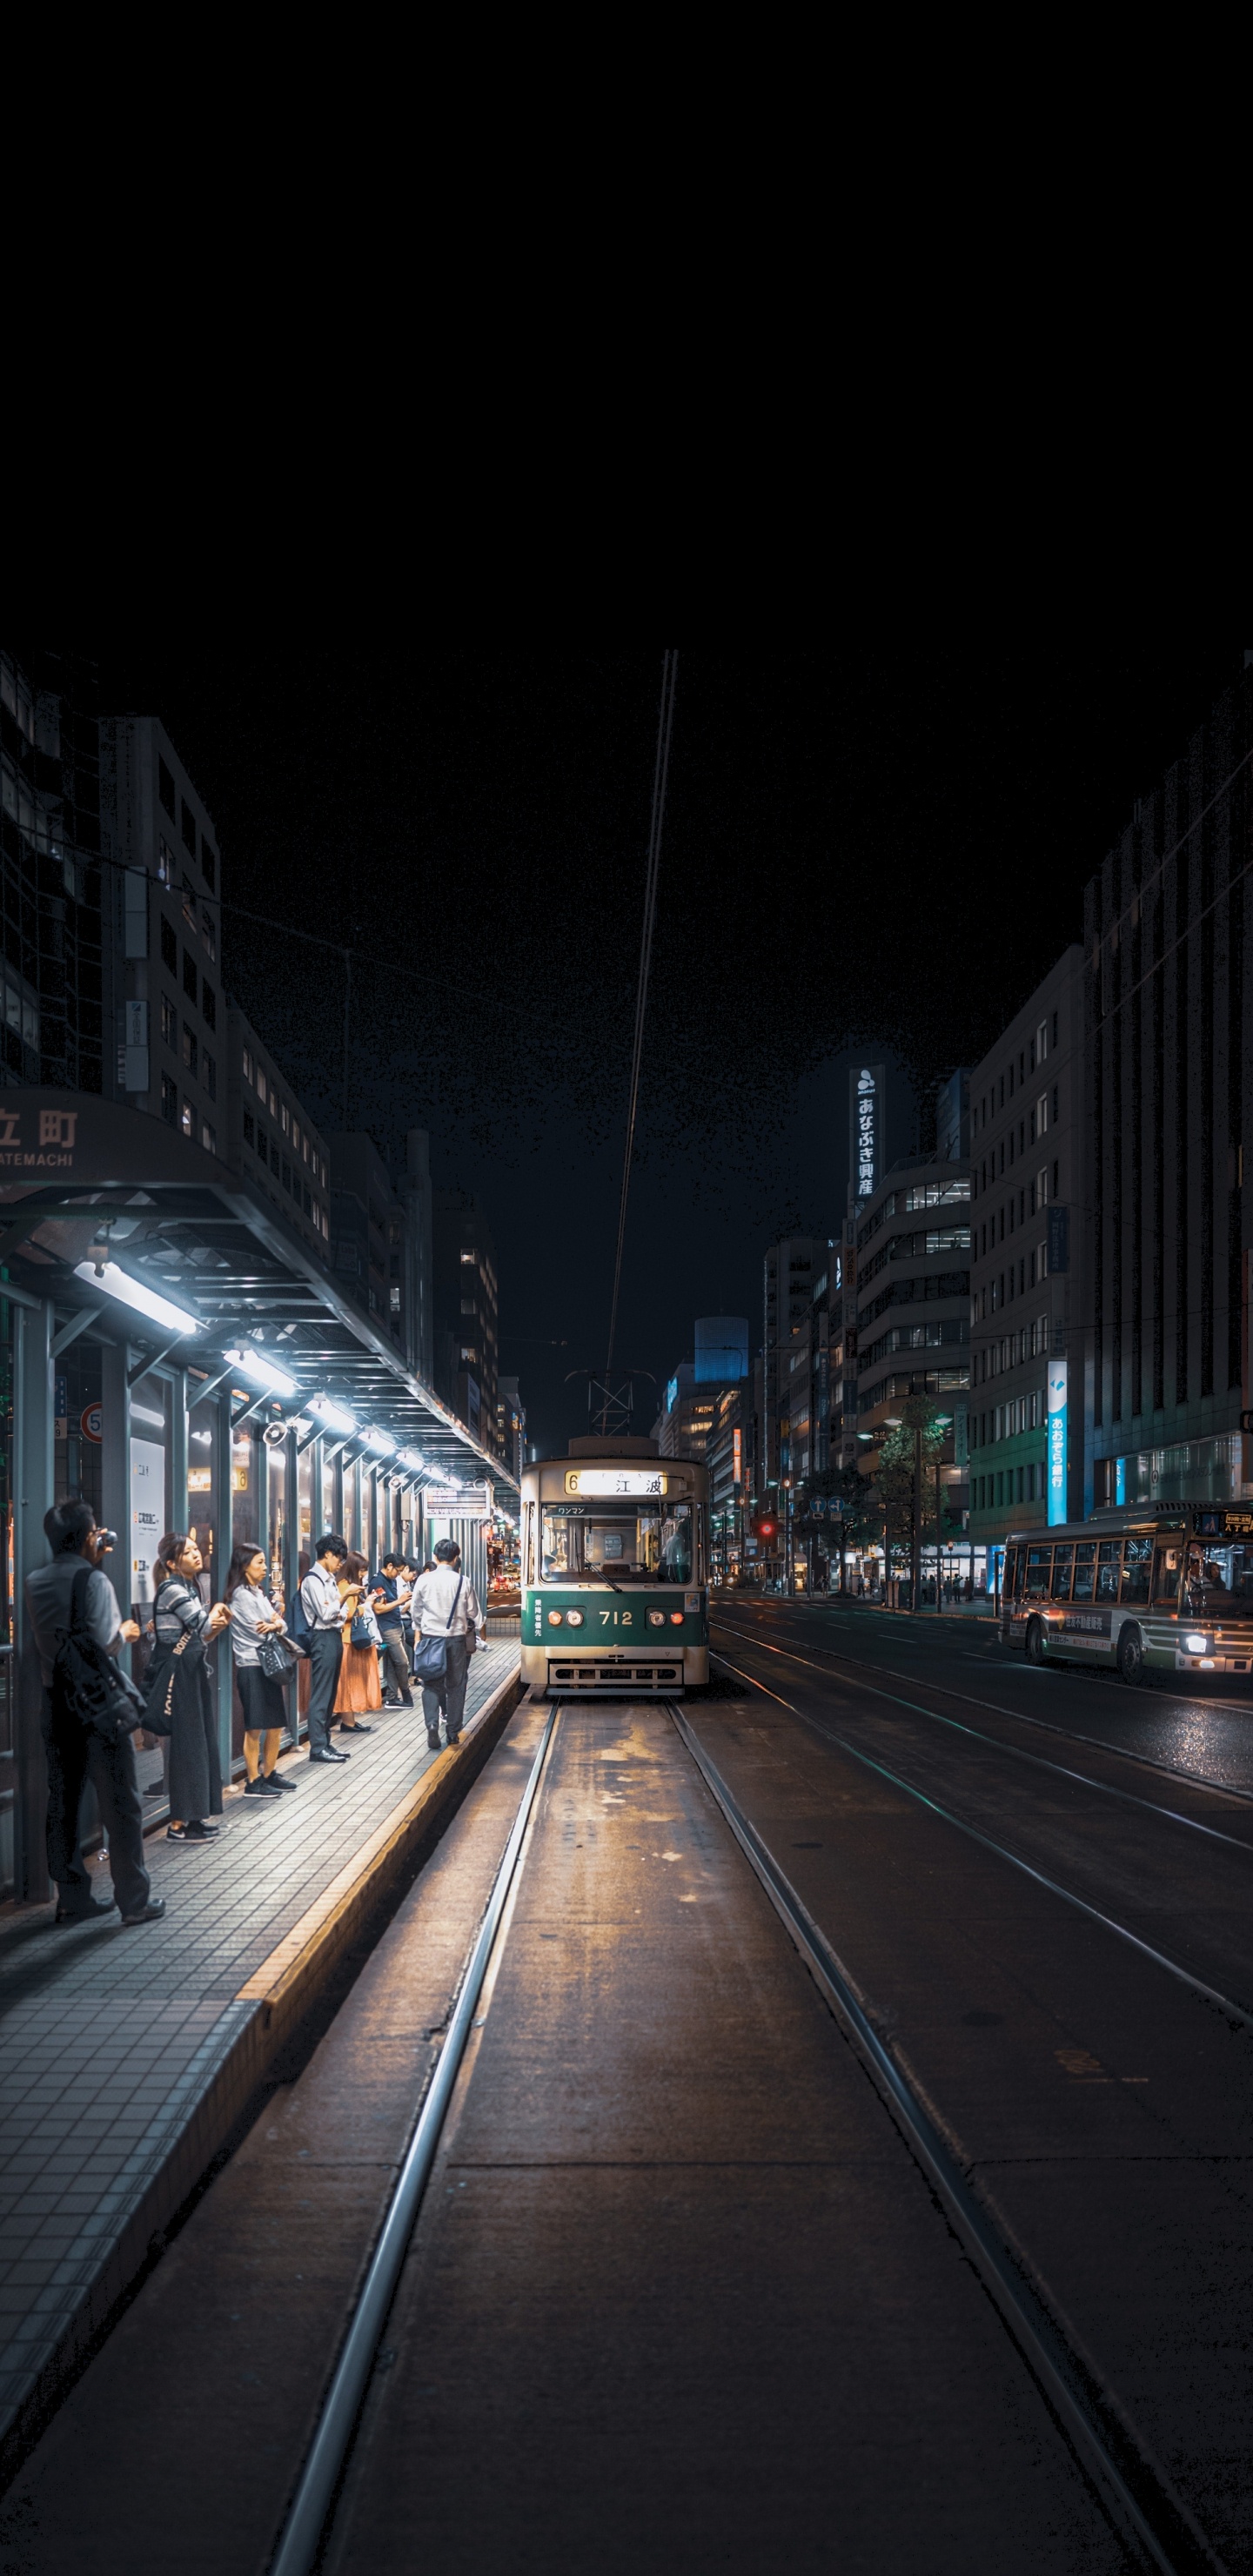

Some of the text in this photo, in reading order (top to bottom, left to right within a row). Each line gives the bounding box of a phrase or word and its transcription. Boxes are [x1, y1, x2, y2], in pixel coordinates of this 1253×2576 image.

[0, 1109, 78, 1148] 立町
[858, 1099, 874, 1196] あなぶき興産
[90, 1414, 101, 1432] 5
[1051, 1418, 1063, 1488] あおぞら銀行
[569, 1474, 578, 1491] 6
[616, 1479, 662, 1493] 江波
[599, 1611, 633, 1626] 712
[1065, 1614, 1102, 1631] 住友不動産販売
